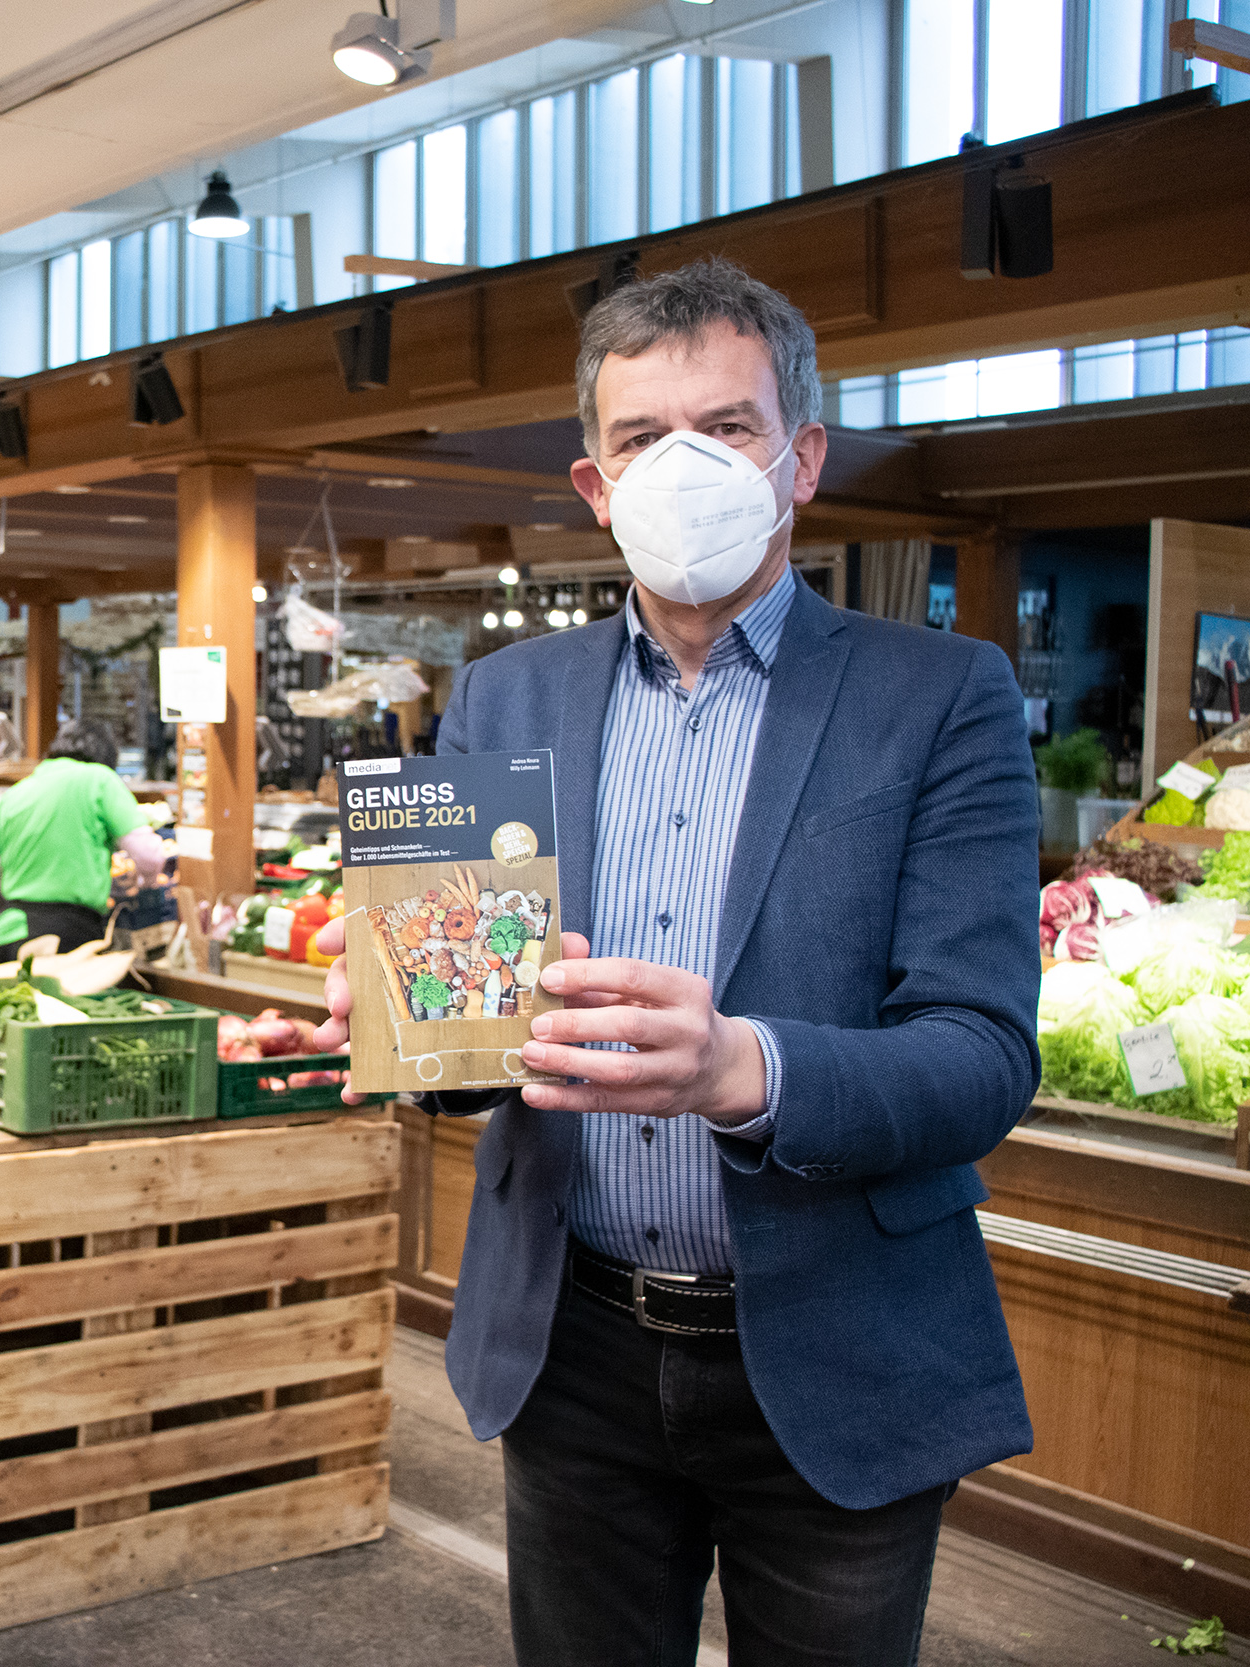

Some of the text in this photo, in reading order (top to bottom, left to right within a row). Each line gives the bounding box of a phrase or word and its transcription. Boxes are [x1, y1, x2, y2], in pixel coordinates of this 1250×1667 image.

[347, 782, 455, 809] GENUSS
[348, 805, 476, 832] GUIDE 2021
[496, 831, 521, 845] WAREN
[350, 846, 380, 854] Geheimtipps
[351, 853, 362, 861] Über
[363, 853, 377, 861] 1.000
[377, 850, 431, 860] Lebensmittelgeschäfte
[502, 844, 531, 859] SPEISEN
[505, 852, 532, 866] SPEZIAL
